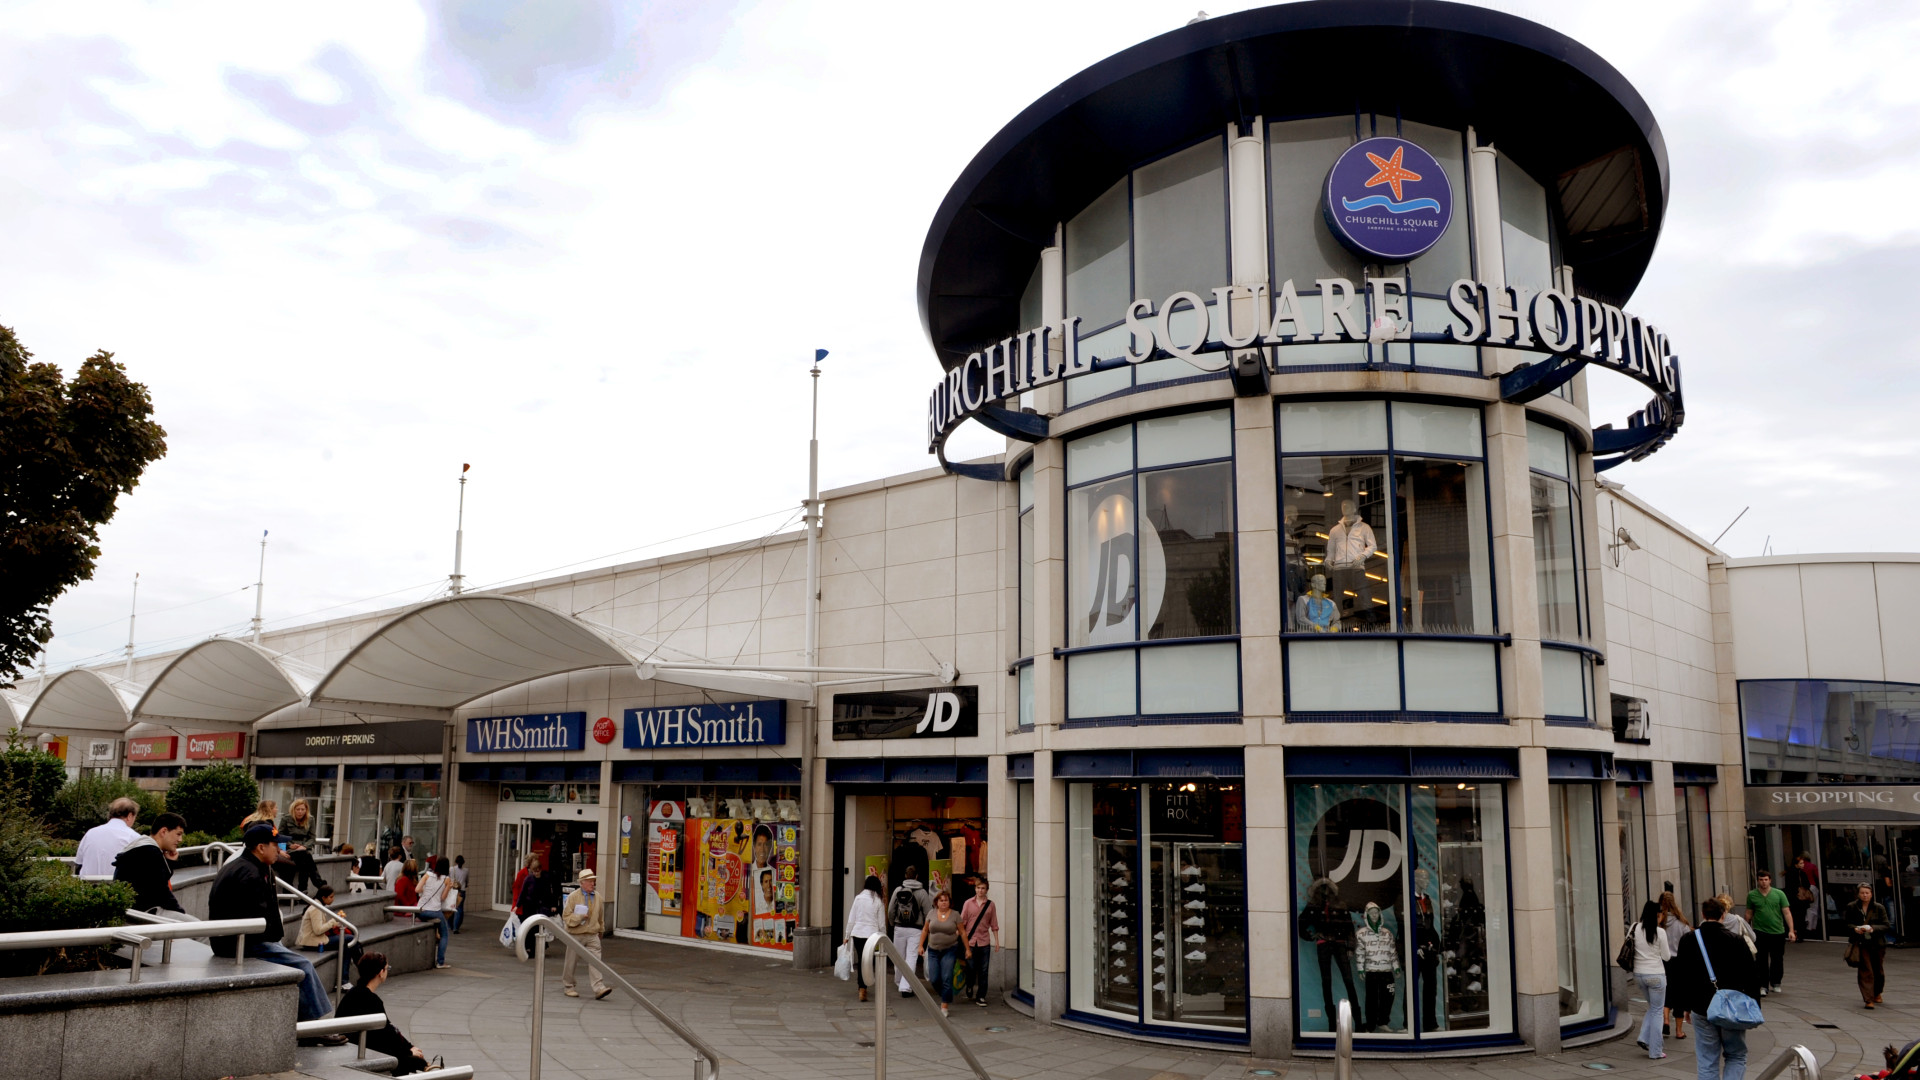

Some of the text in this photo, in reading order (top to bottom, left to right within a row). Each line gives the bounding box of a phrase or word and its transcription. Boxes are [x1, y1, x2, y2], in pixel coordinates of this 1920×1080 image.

[1345, 215, 1439, 228] CHURCHILL SQUARE
[1125, 277, 1413, 372] SQUARE
[1448, 278, 1677, 394] SHOPPING
[1089, 532, 1136, 634] JD
[635, 704, 764, 746] WHSmith
[916, 692, 960, 734] JD
[305, 734, 375, 746] DOROTHY PERKINS
[475, 714, 568, 750] WHSmith
[1771, 791, 1895, 803] SHOPPING
[661, 834, 676, 842] HALF
[710, 834, 726, 842] HALF
[1328, 829, 1404, 883] JD
